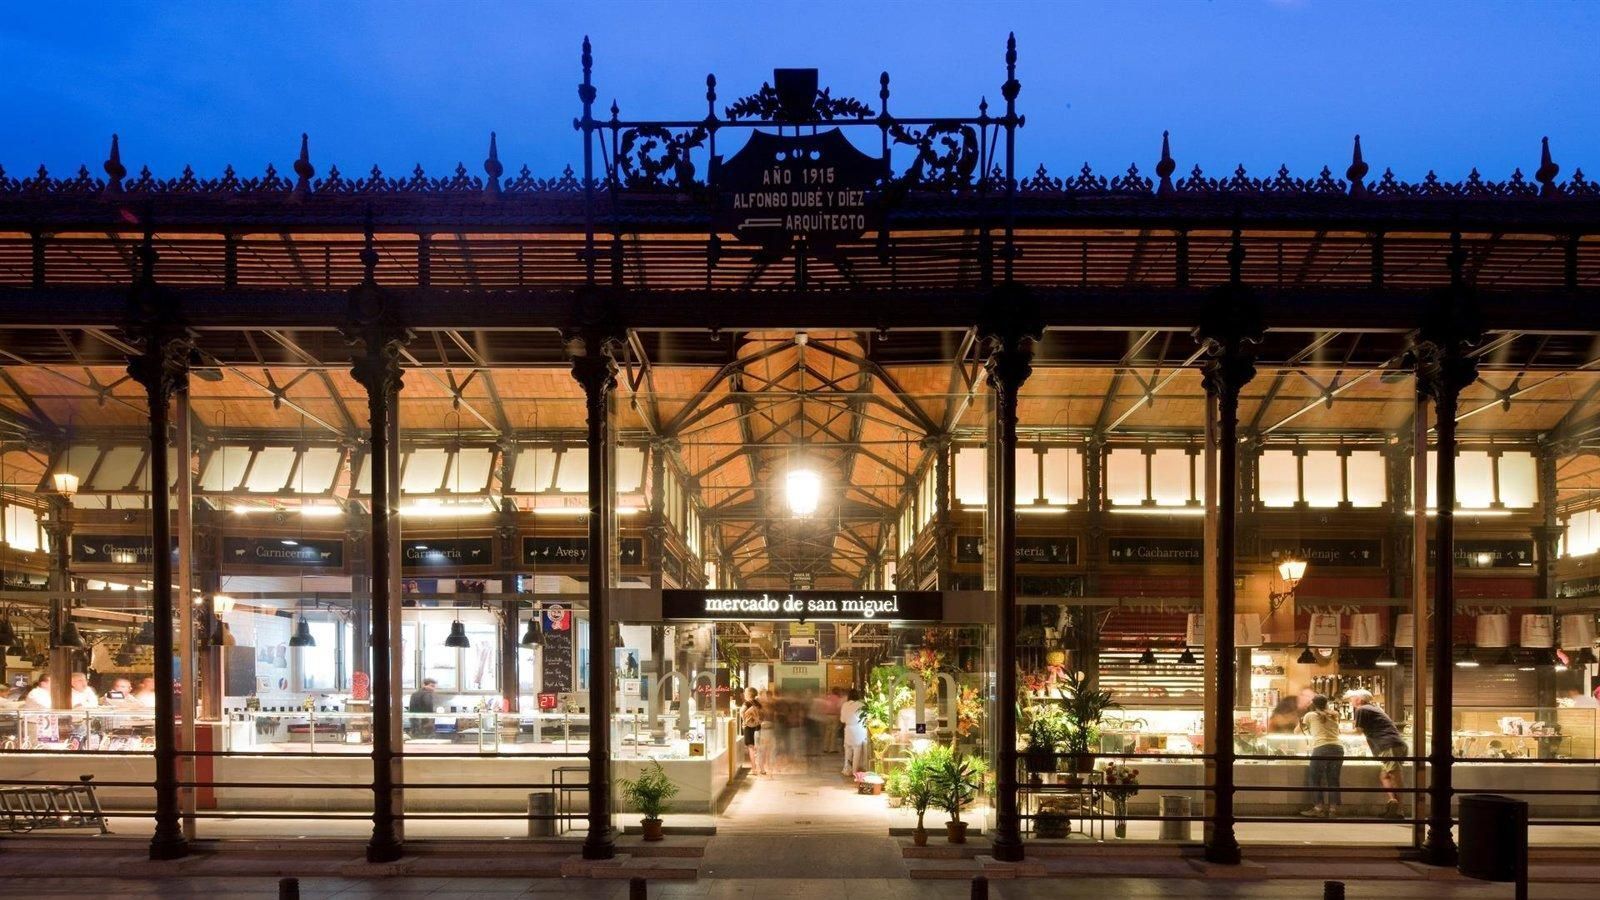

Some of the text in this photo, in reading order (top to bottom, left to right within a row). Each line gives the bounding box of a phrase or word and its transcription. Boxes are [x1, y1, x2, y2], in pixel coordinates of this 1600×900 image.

[763, 165, 834, 185] AÑO 1915
[734, 192, 788, 208] ALFONSO
[791, 186, 823, 207] DUBÉ
[827, 191, 834, 207] Y
[555, 546, 587, 561] Aves y
[1301, 547, 1341, 561] Menaje
[705, 594, 899, 618] mercado de san miguel
[540, 696, 555, 707] 27
